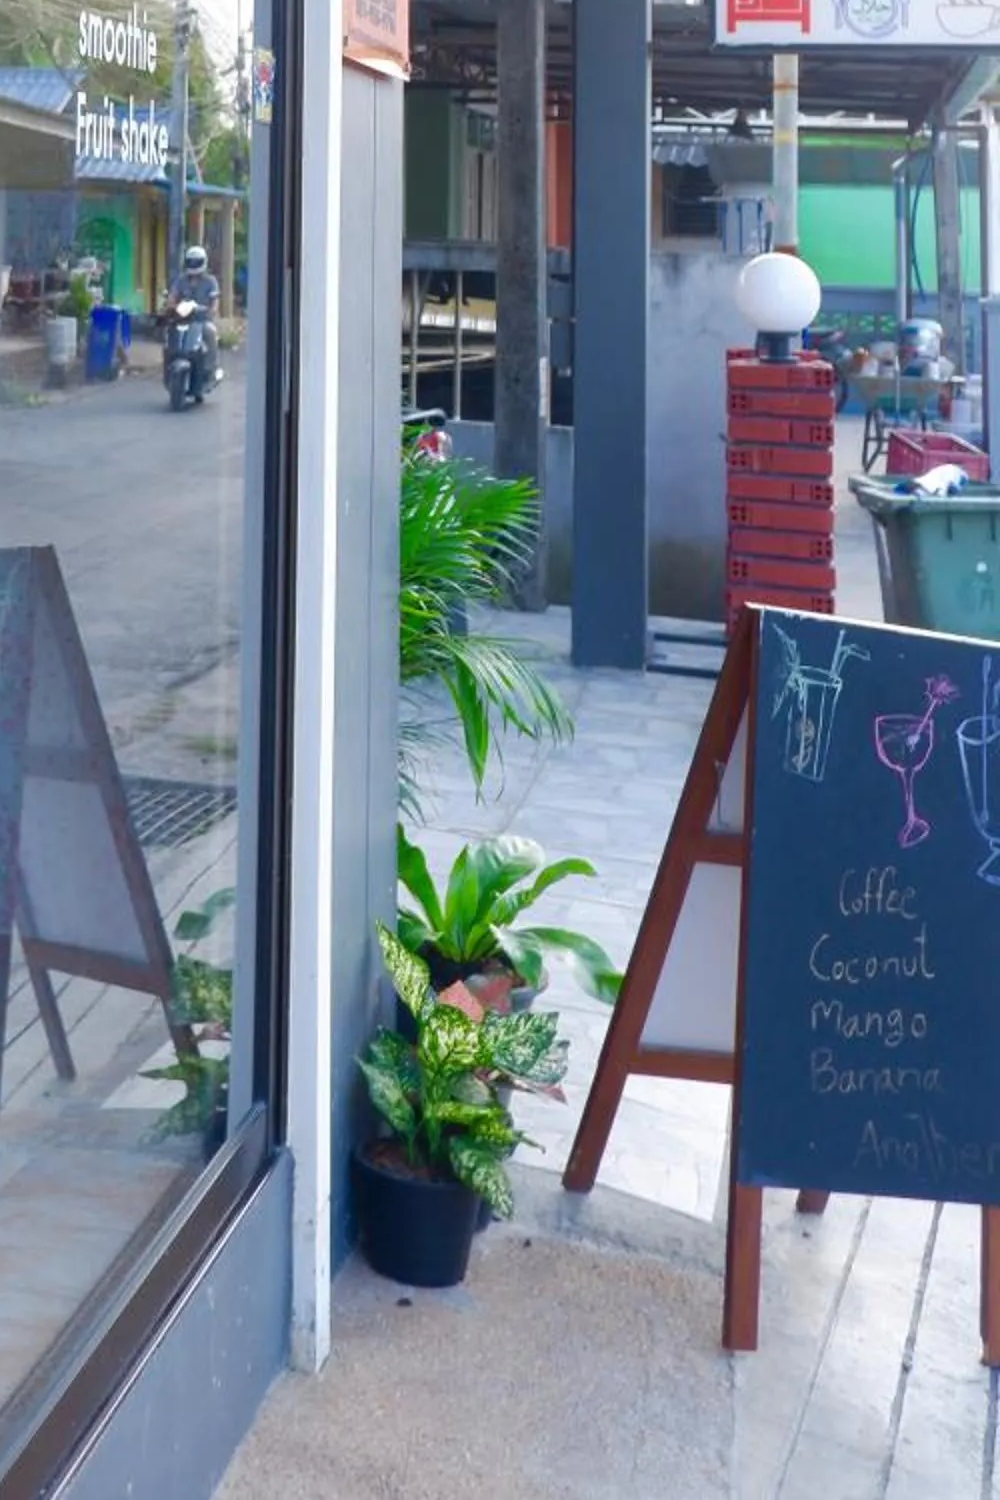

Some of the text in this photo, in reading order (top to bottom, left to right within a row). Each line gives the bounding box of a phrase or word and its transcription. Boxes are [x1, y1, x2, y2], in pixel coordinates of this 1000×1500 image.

[79, 2, 158, 73] smoothie
[75, 91, 169, 168] Fruit shake
[838, 865, 919, 920] Coffee
[808, 922, 937, 984] Coconut
[809, 999, 928, 1047] Mango
[809, 1047, 945, 1095] Banana
